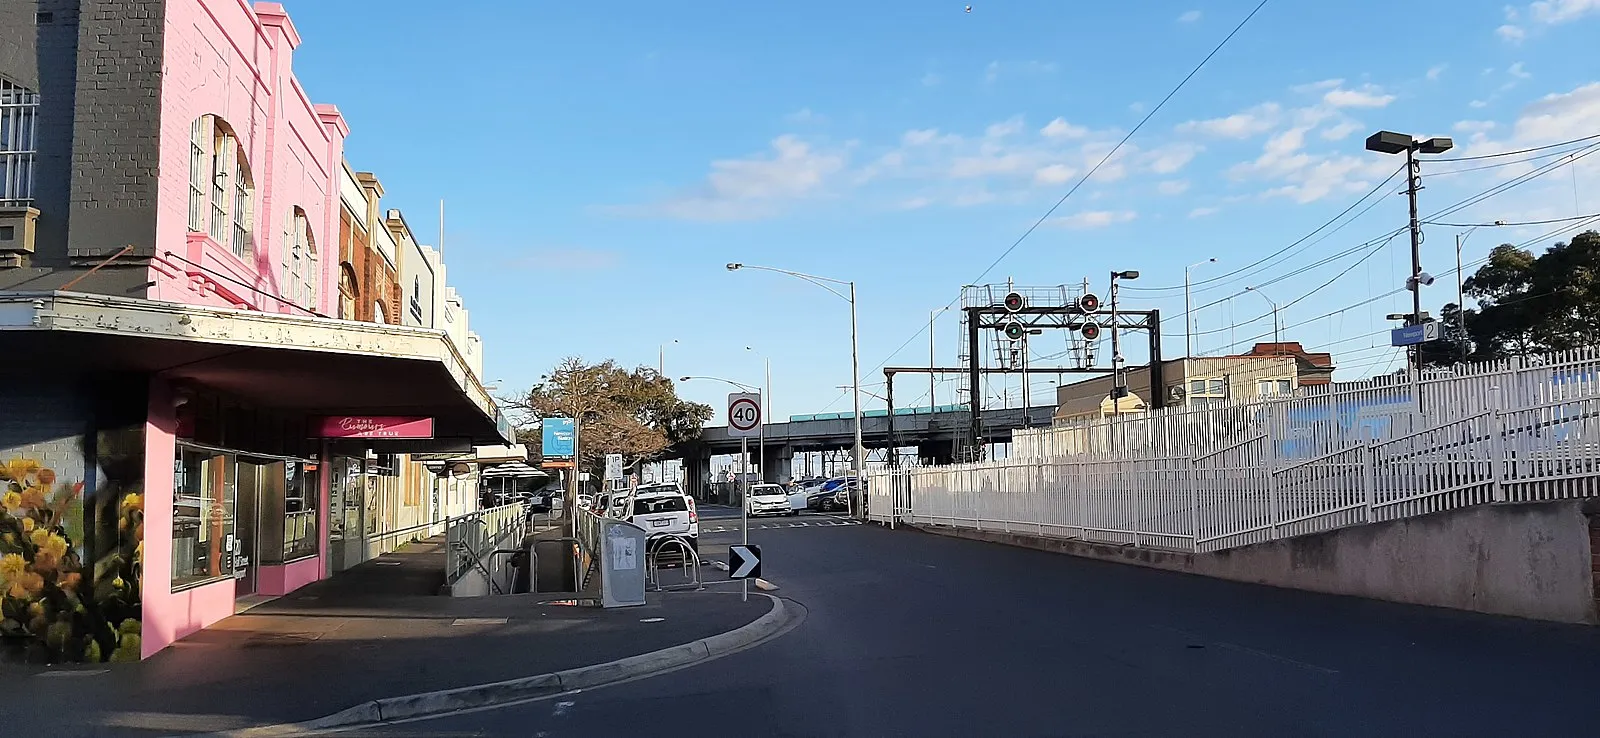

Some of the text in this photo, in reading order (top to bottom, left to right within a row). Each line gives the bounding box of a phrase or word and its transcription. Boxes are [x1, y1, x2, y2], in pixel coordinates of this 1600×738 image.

[1402, 323, 1434, 339] Newport 2
[733, 407, 755, 422] 40
[339, 417, 387, 431] Rumours
